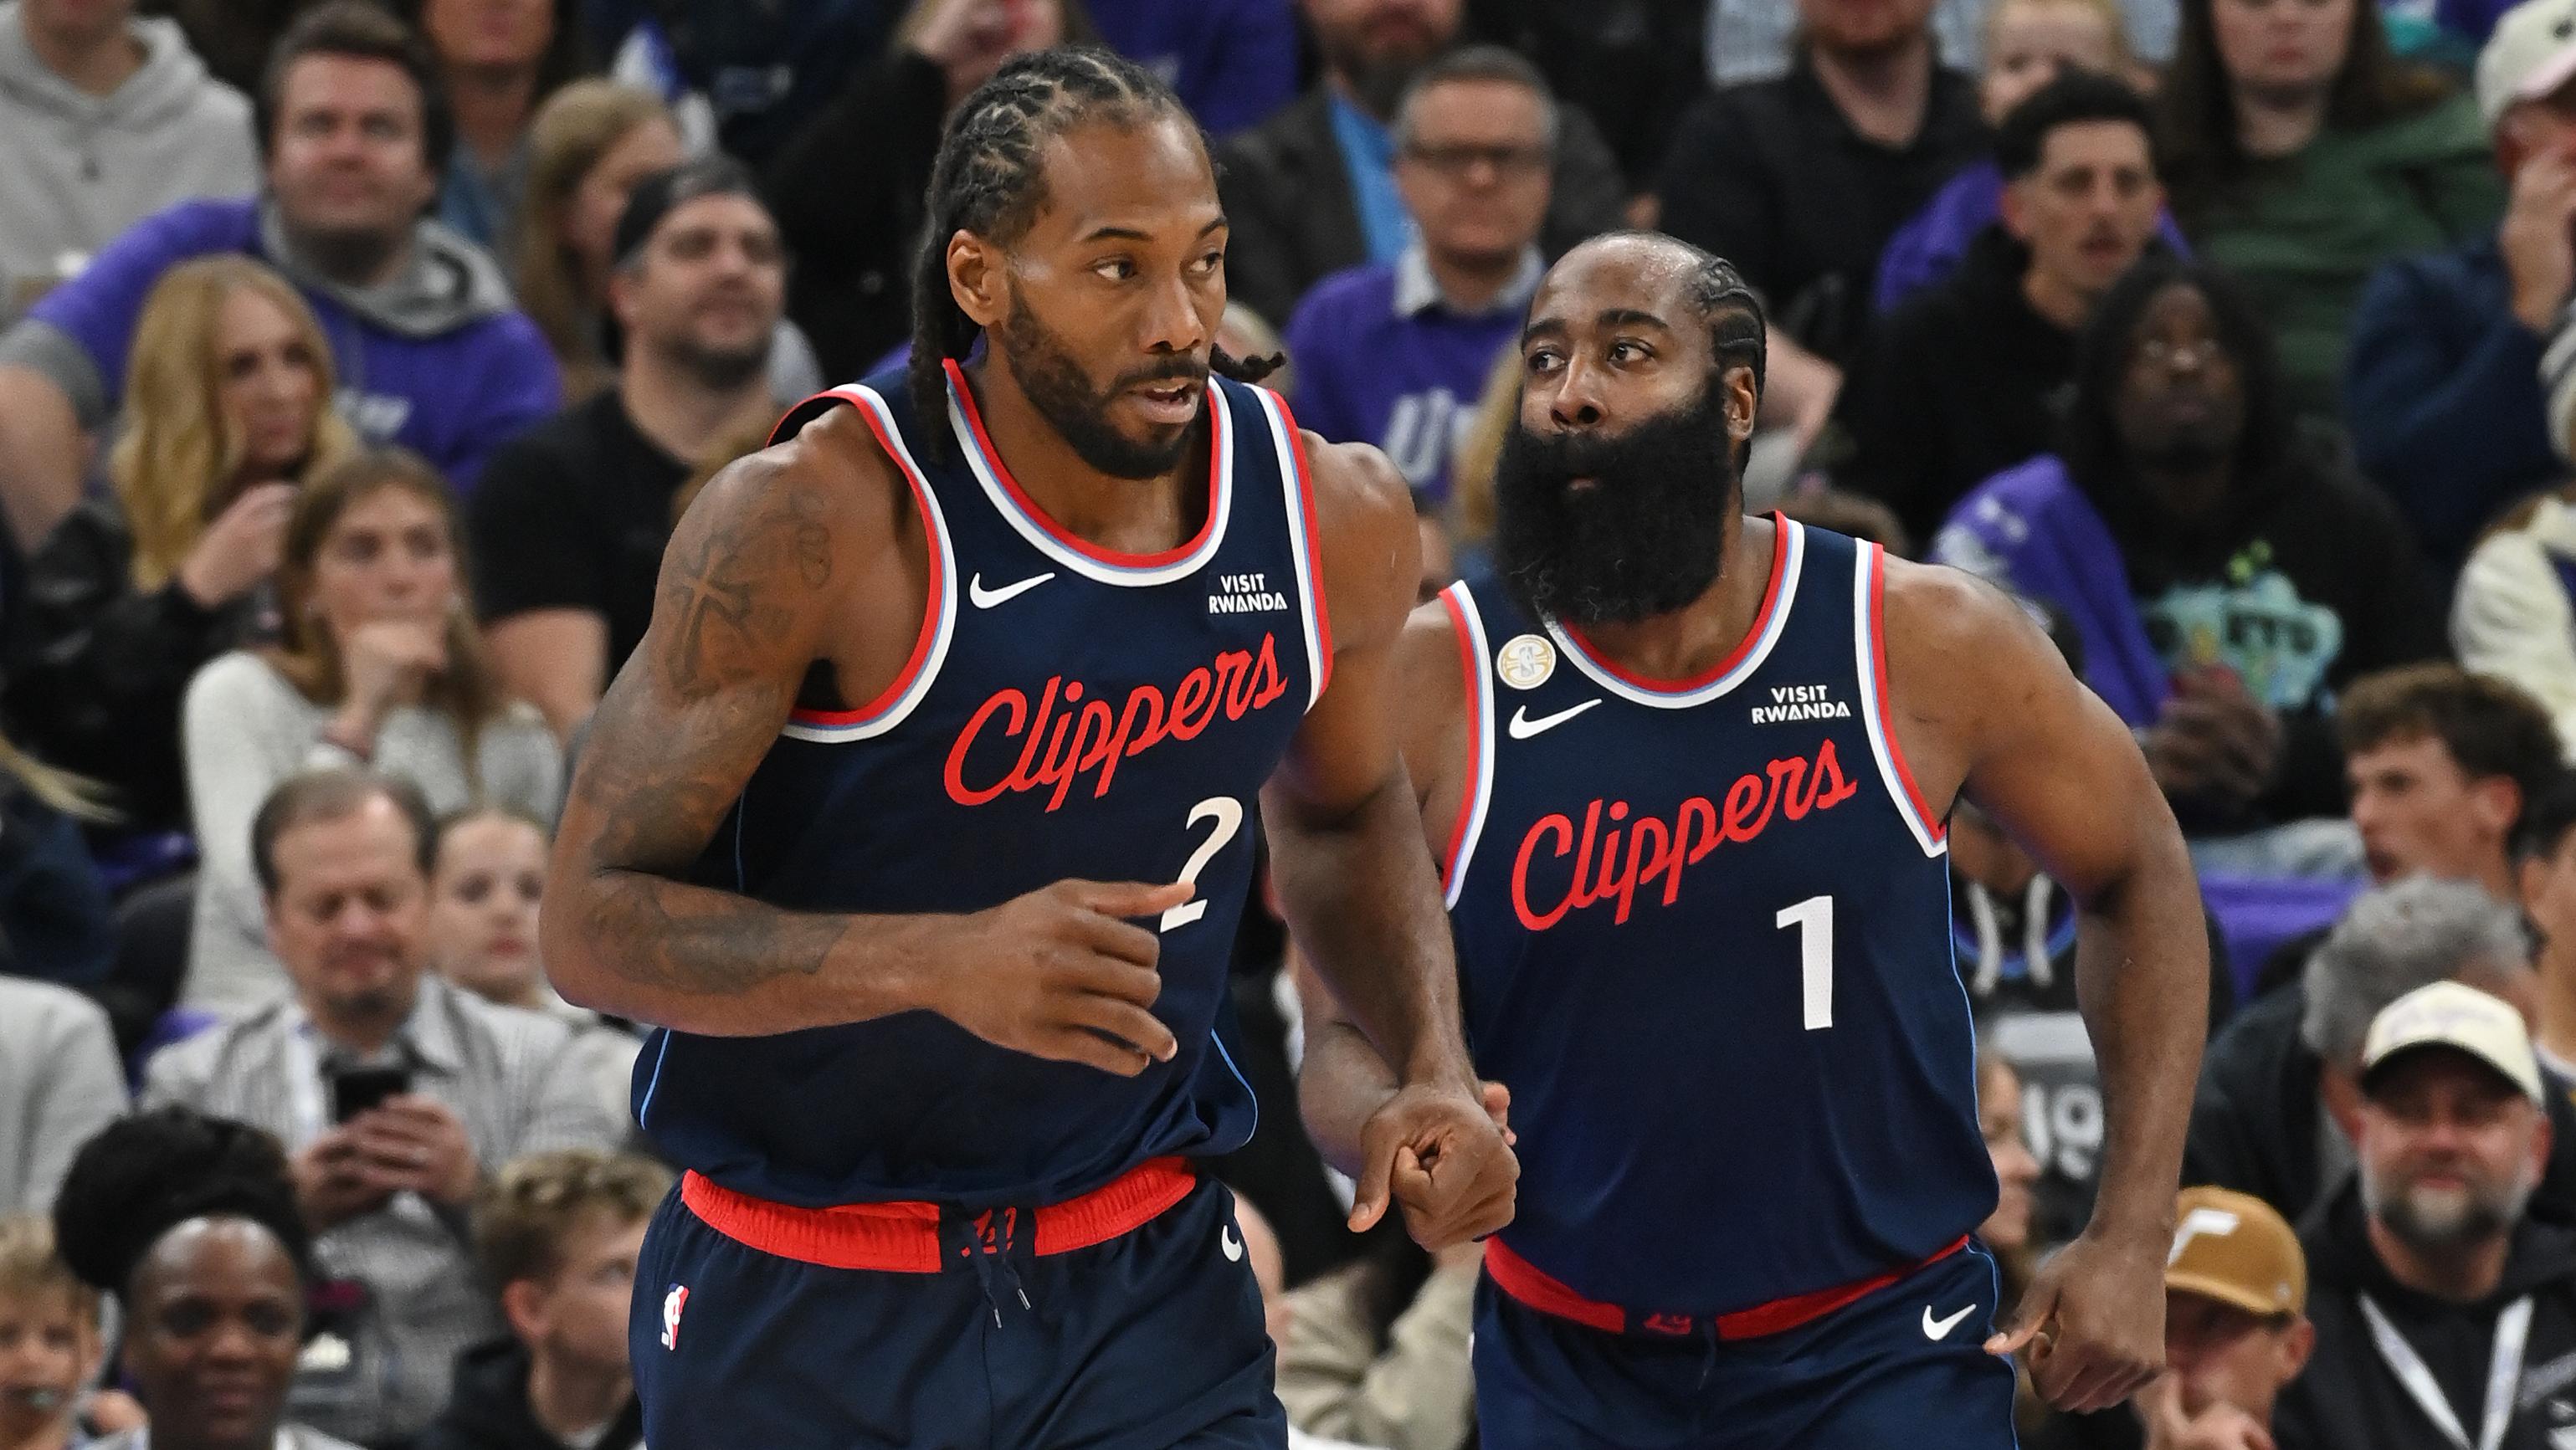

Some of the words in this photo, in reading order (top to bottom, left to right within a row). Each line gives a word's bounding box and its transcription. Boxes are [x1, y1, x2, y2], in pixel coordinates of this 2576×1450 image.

[1209, 592, 1288, 613] RWANDA
[1220, 574, 1265, 593] VISIT
[943, 631, 1287, 812] Clippers
[1752, 701, 1850, 724] RWANDA
[1770, 685, 1827, 703] VISIT
[1161, 797, 1242, 932] 2
[1511, 739, 1857, 930] Clippers
[1777, 895, 1833, 1030] 1
